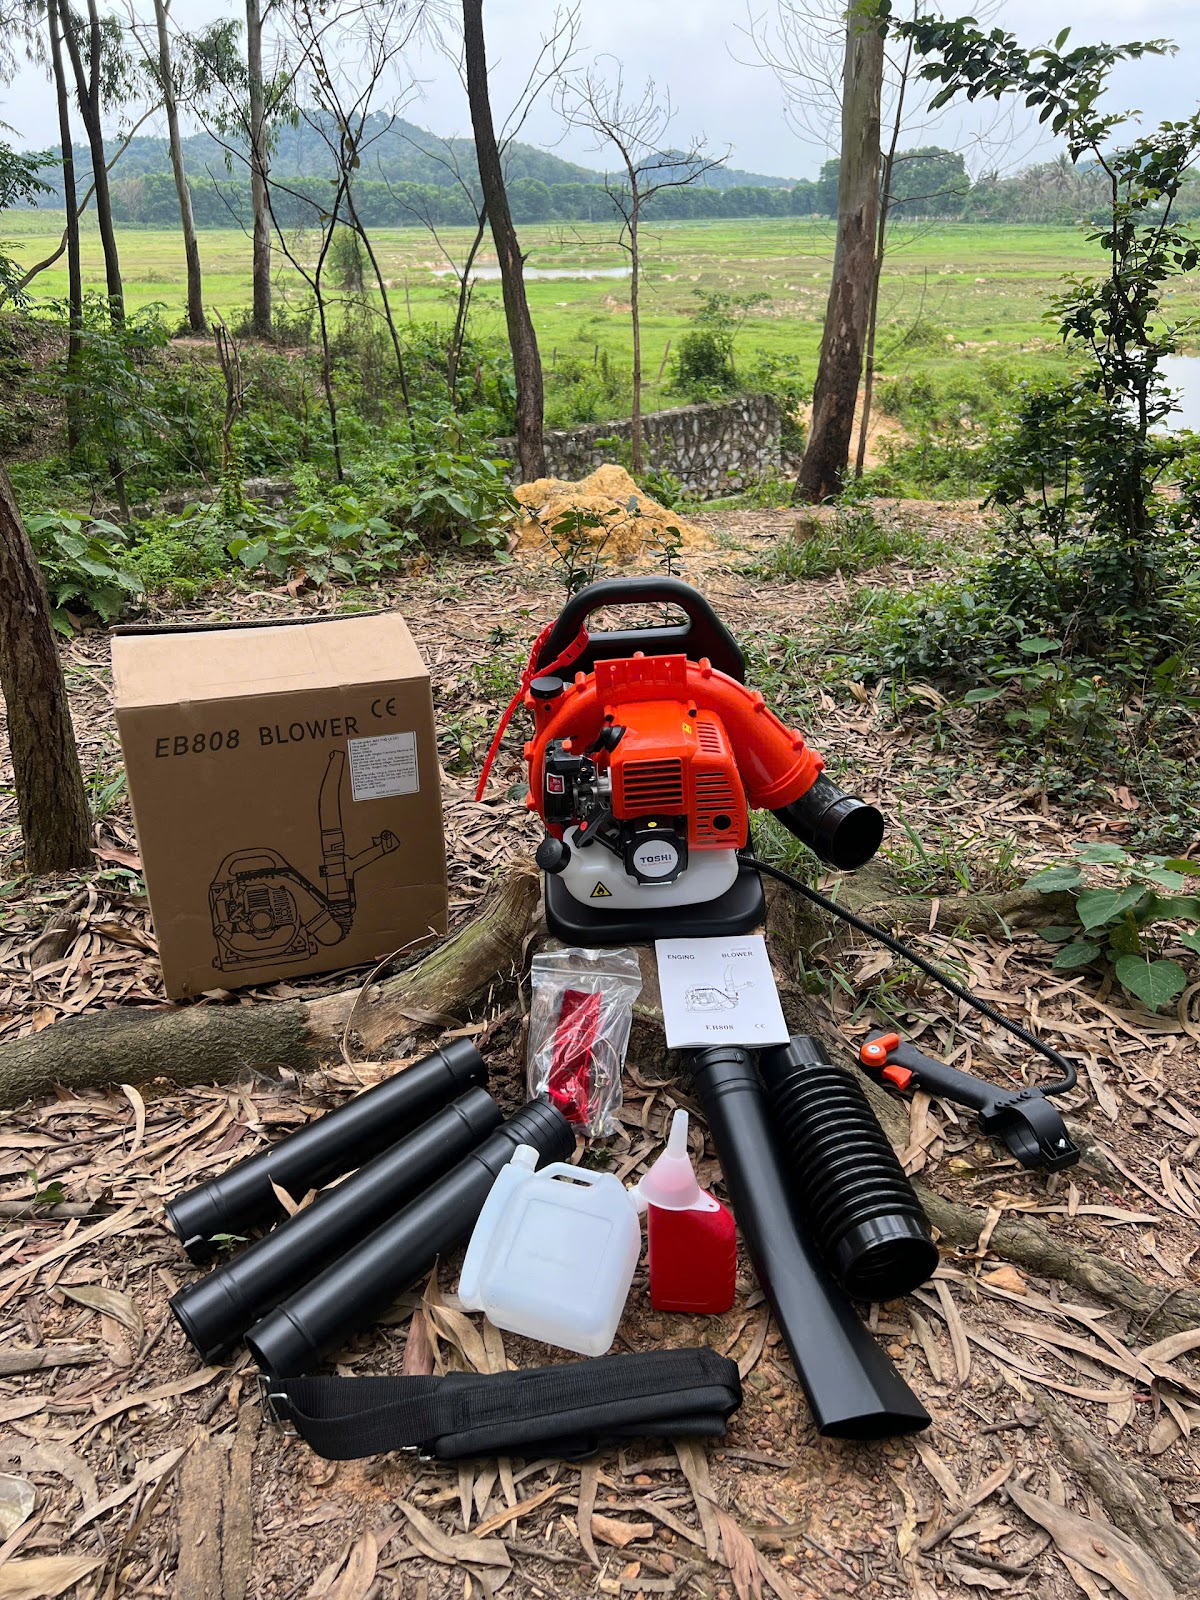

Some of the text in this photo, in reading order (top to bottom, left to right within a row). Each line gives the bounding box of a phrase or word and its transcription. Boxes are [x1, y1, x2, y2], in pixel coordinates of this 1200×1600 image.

[155, 729, 241, 759] EB808
[259, 716, 360, 746] BLOWER
[640, 854, 672, 863] TOSHI
[721, 951, 753, 959] BLOWER
